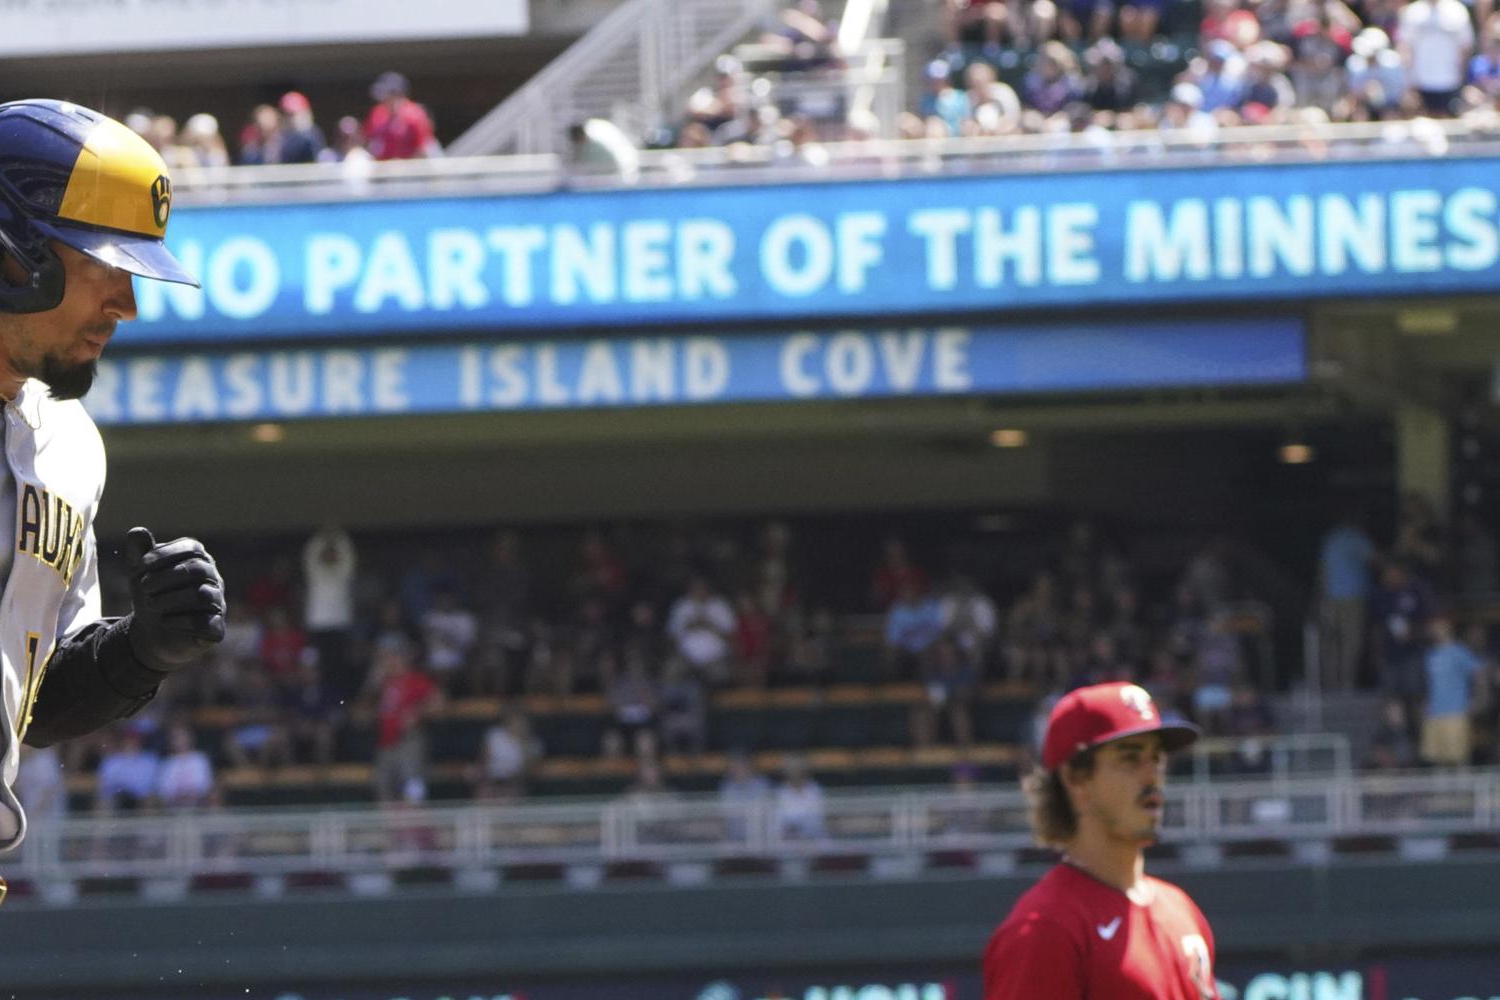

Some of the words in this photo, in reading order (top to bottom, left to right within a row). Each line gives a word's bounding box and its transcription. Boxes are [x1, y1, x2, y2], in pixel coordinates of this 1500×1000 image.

[303, 217, 738, 315] PARTNER
[759, 210, 888, 298] OF
[908, 201, 1101, 290] THE
[97, 346, 411, 424] REASURE
[459, 335, 730, 412] ISLAND
[778, 327, 973, 399] COVE
